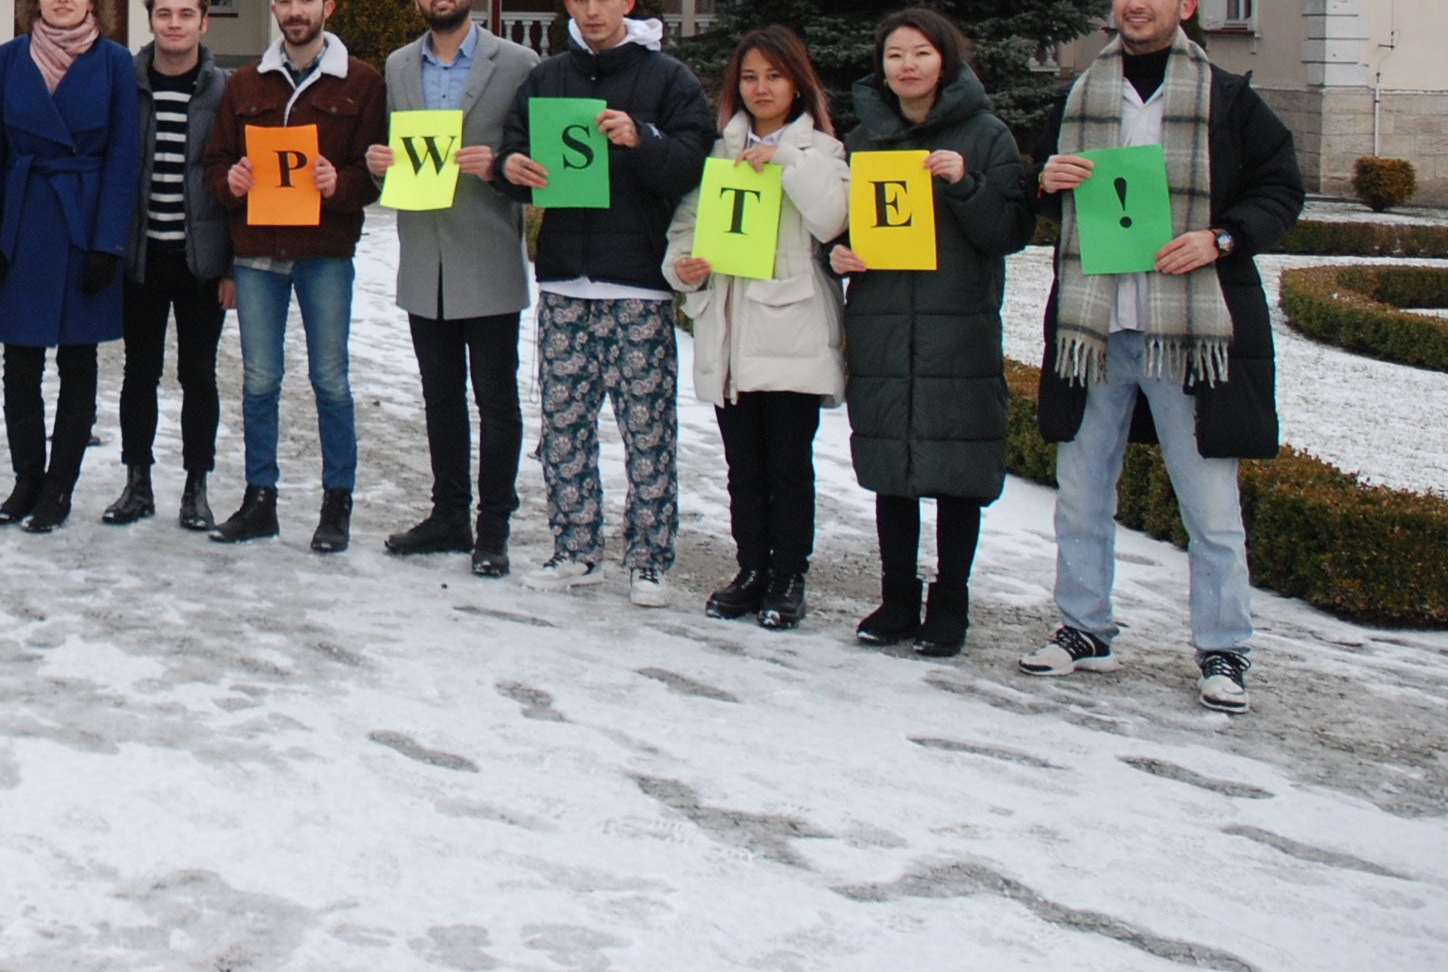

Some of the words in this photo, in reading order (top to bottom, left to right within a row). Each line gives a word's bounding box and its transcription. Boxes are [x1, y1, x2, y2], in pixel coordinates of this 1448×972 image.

[274, 149, 308, 188] P
[402, 135, 458, 177] W
[561, 124, 595, 170] S
[720, 187, 762, 235] T
[871, 180, 913, 228] E
